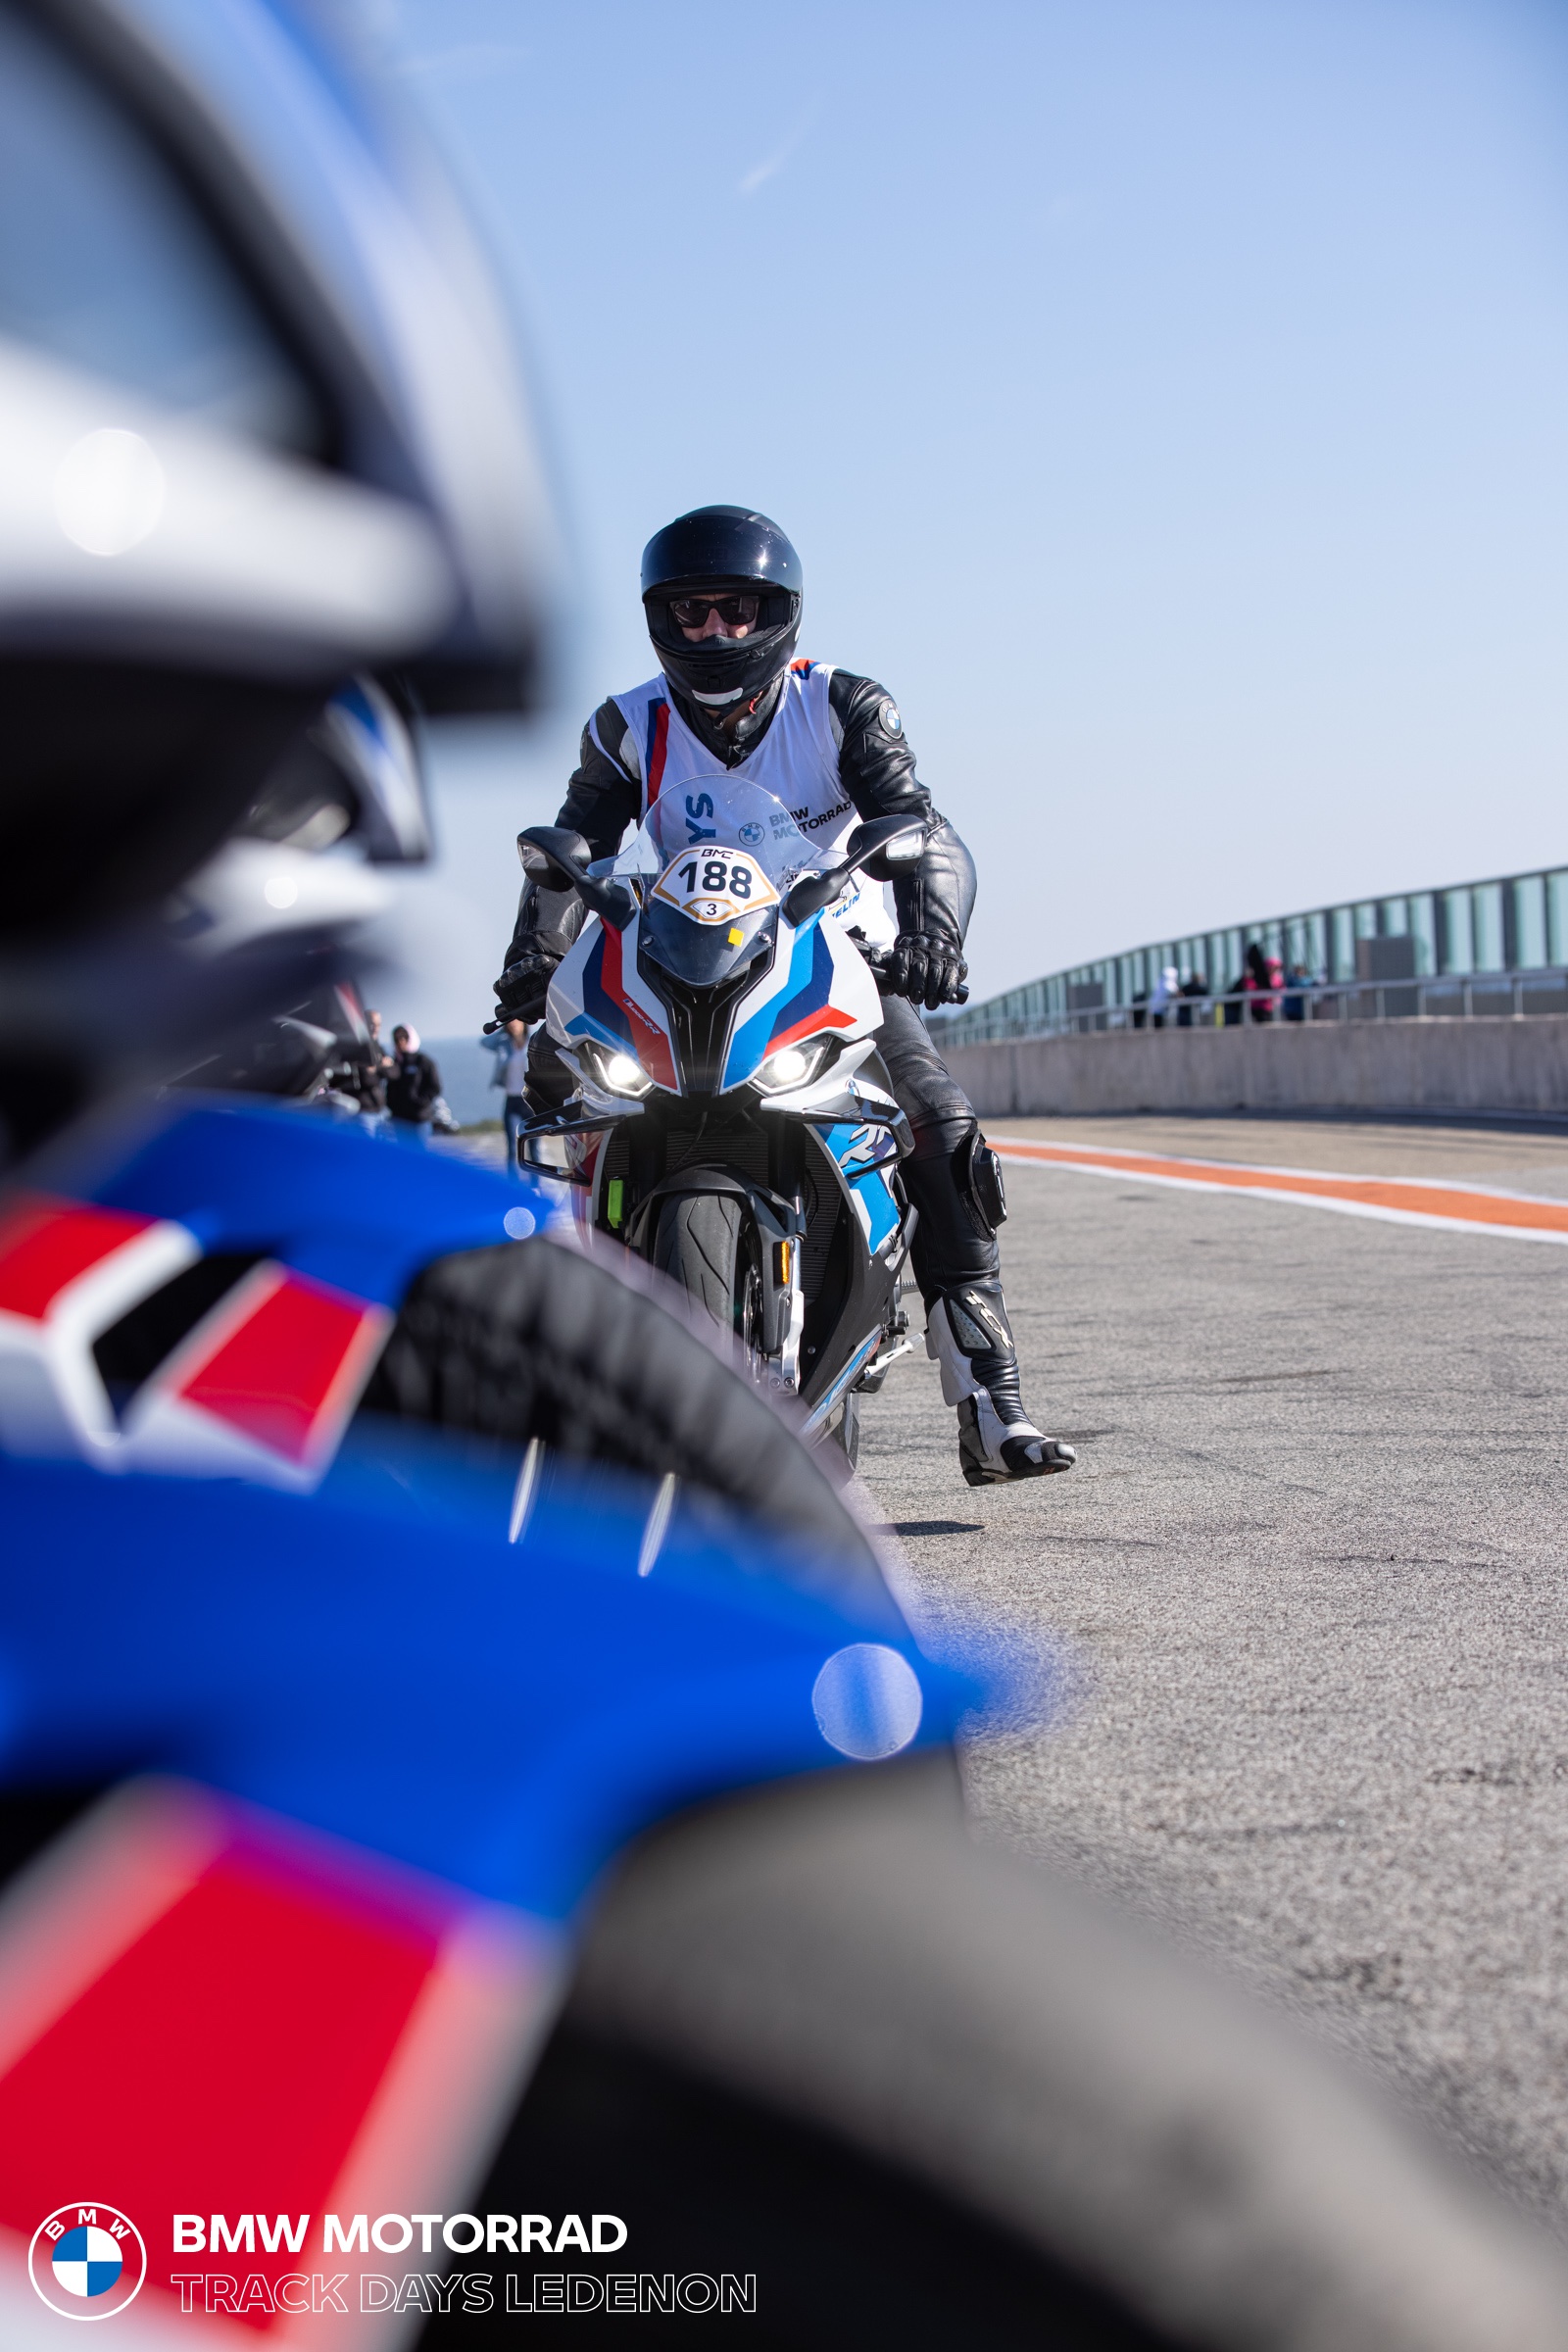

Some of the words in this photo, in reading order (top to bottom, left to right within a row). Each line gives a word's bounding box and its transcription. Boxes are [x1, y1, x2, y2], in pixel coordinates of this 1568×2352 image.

[768, 807, 809, 827] BMW
[772, 801, 852, 841] MOTORRAD
[701, 849, 734, 859] BMC
[677, 860, 753, 900] 188
[706, 903, 717, 916] 3
[832, 892, 860, 919] ELIN
